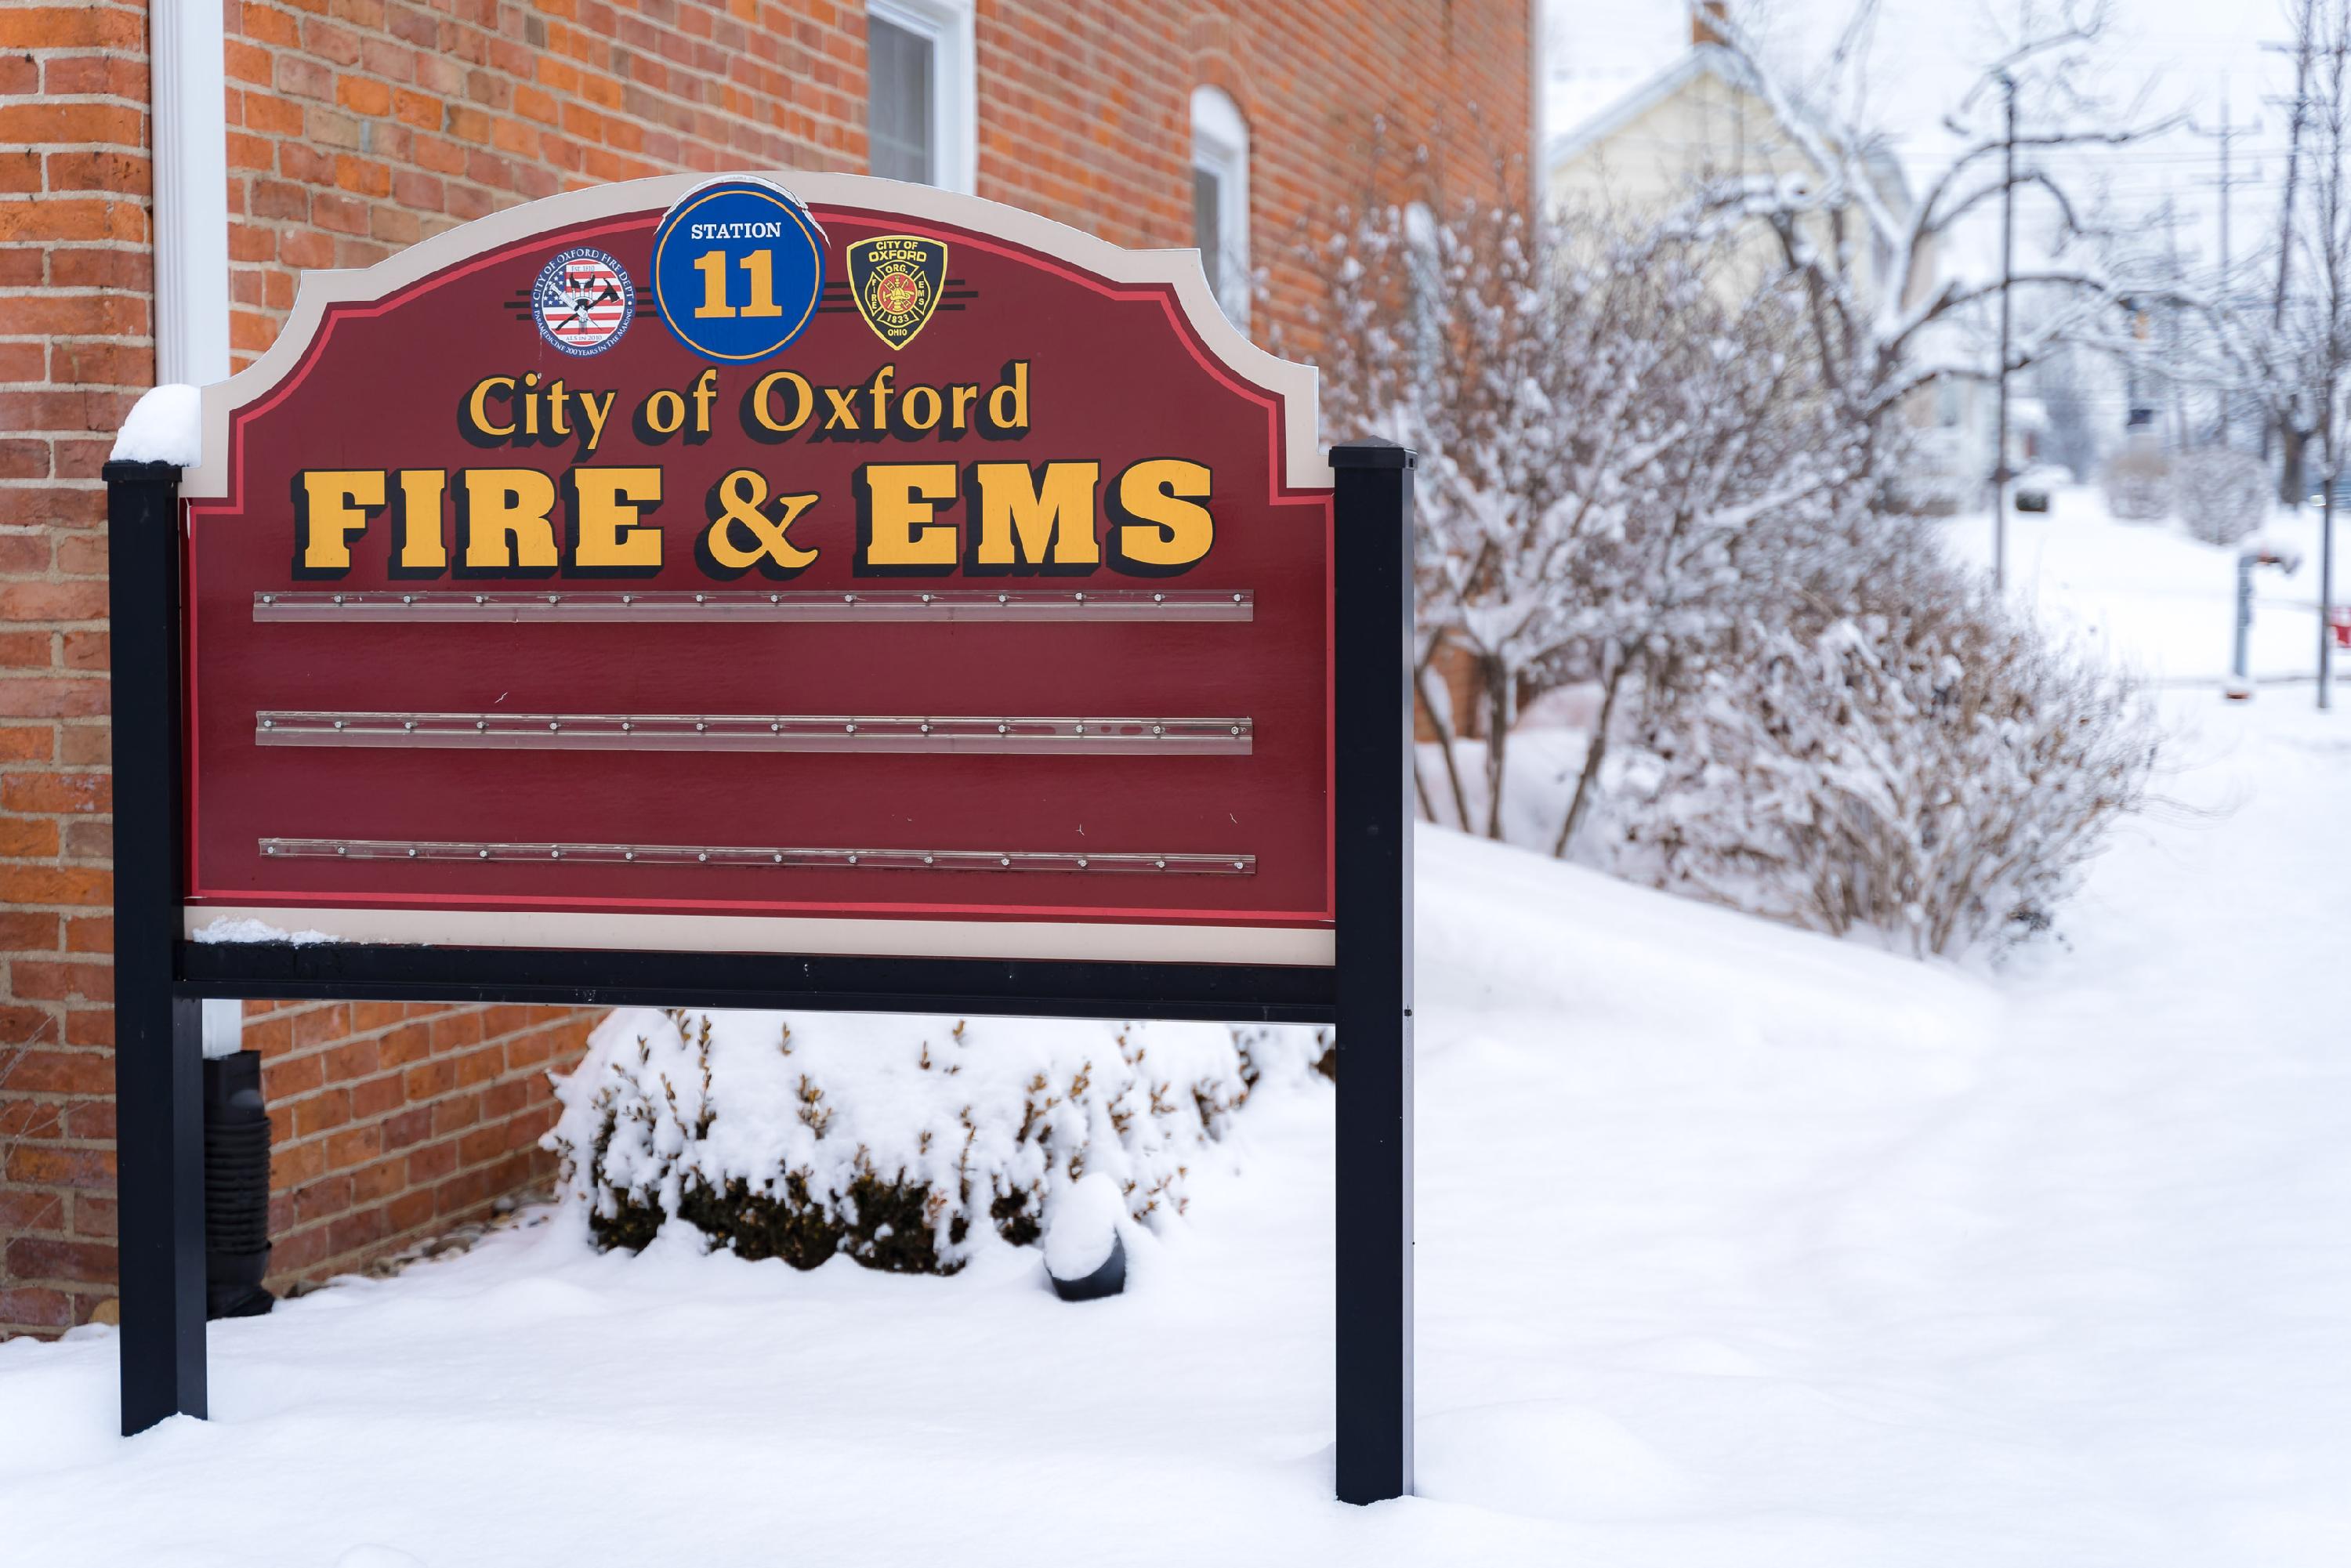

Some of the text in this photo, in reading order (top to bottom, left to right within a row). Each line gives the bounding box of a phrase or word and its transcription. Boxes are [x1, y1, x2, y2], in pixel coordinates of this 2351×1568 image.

[691, 222, 782, 239] STATION
[876, 241, 918, 250] CITY OF
[868, 250, 927, 263] OXFORD
[886, 264, 908, 273] ORG.
[533, 248, 634, 300] CITY OF OXFORD FIRE DEPT
[694, 249, 782, 318] 11
[534, 310, 566, 352] PARAMEDICINE
[566, 346, 578, 356] 200
[607, 335, 618, 347] THE
[617, 309, 632, 337] MAKING
[886, 314, 909, 324] 1833
[469, 362, 1029, 451] City of Oxford
[304, 459, 1215, 568] FIRE & EMS
